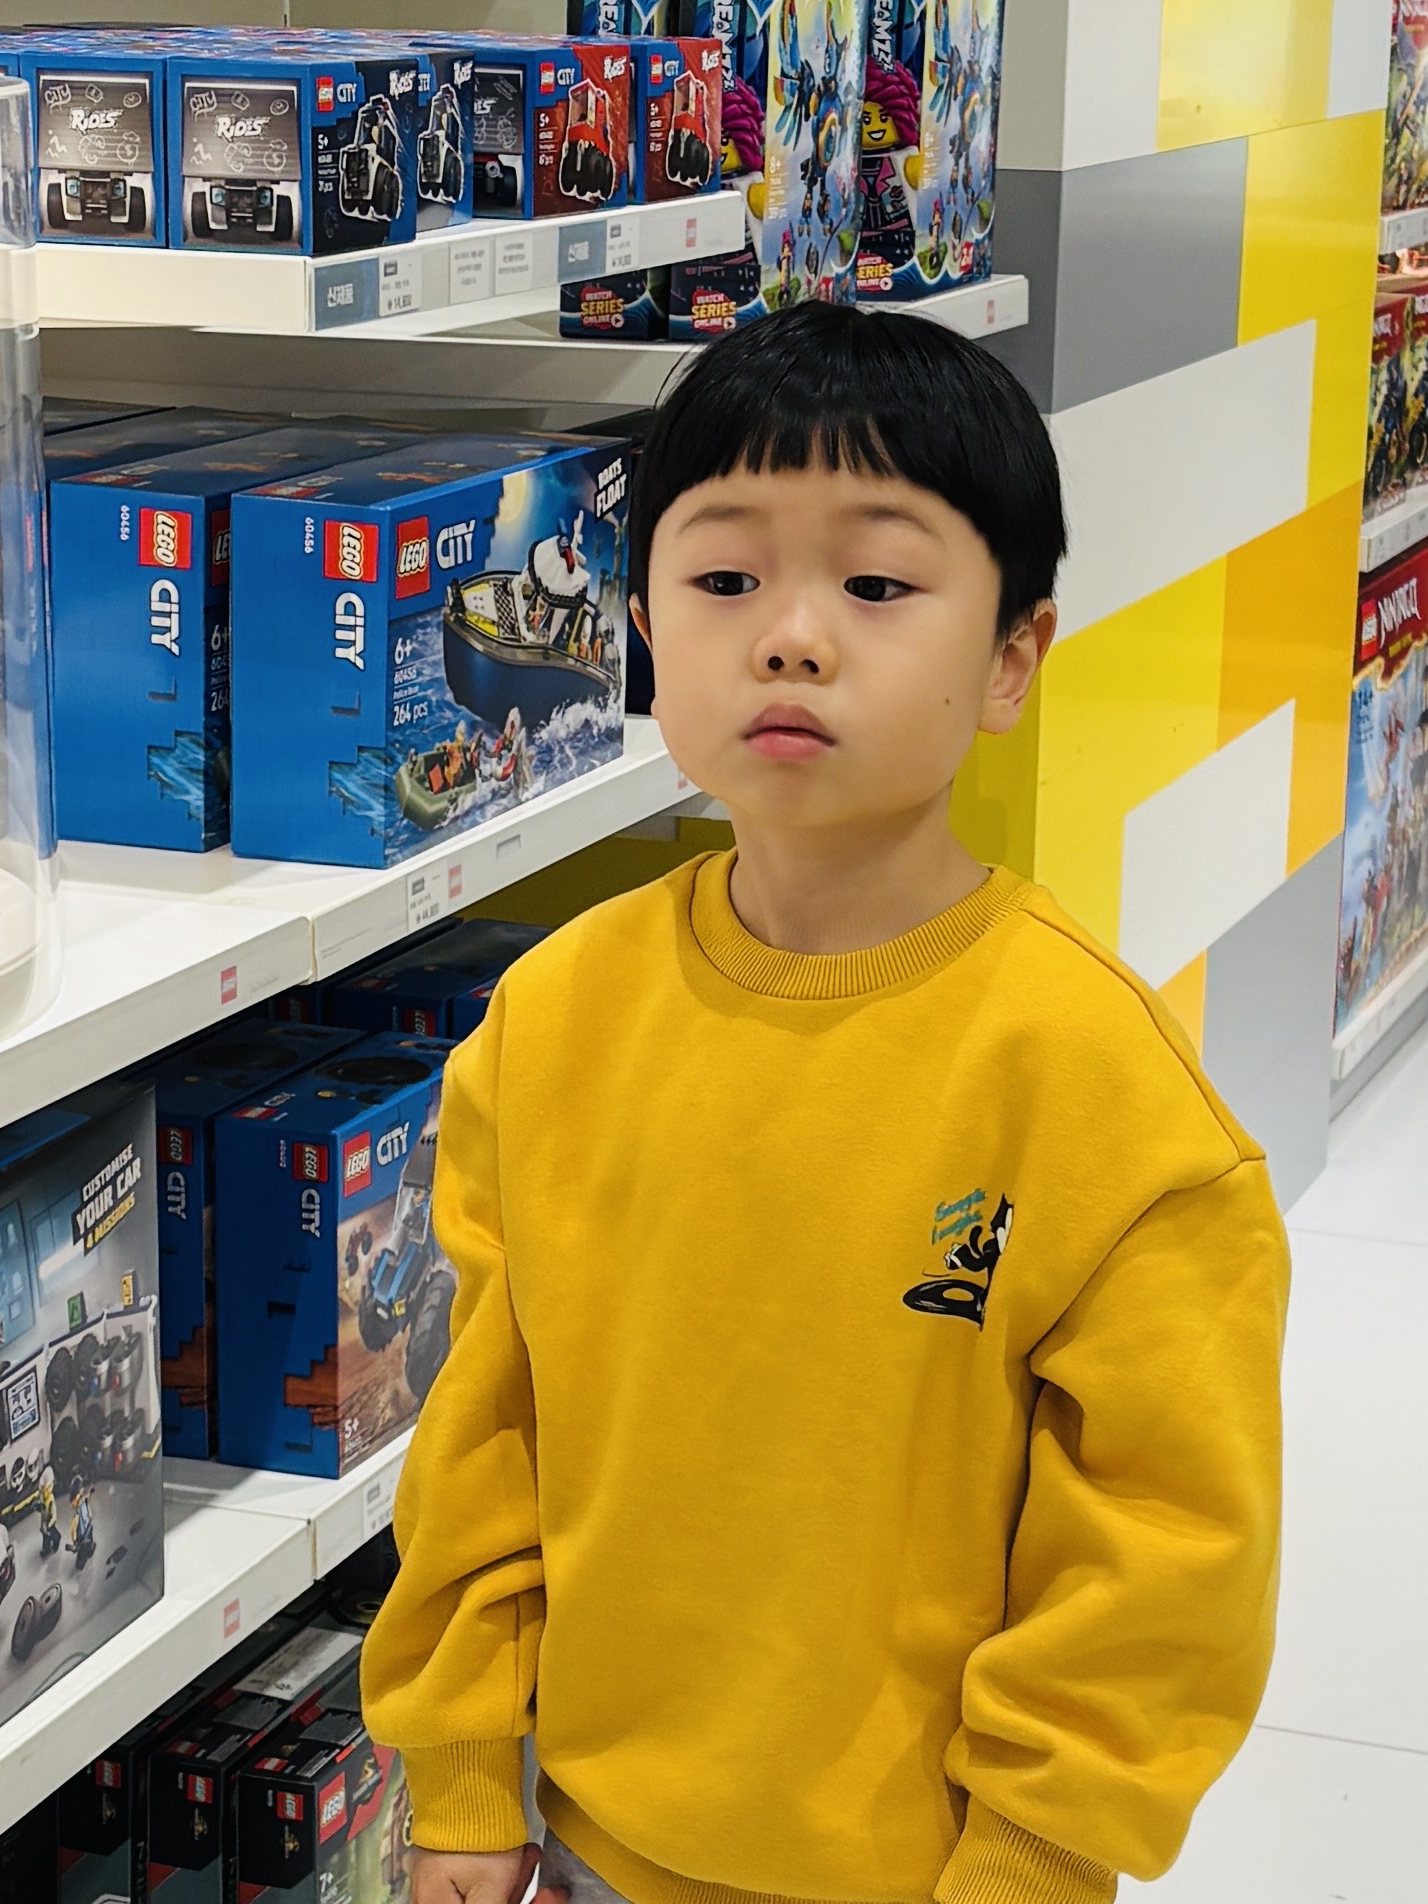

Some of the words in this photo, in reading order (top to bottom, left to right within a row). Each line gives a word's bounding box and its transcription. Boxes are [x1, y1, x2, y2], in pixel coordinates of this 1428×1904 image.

[327, 284, 354, 308] 신제품
[580, 299, 625, 317] SERIES
[691, 301, 737, 318] SERIES
[598, 459, 623, 488] BOATS
[596, 478, 627, 515] FLOAT
[121, 505, 130, 541] 60456
[155, 511, 176, 566] LEGO
[304, 517, 314, 554] 60456
[339, 522, 364, 580] LEGO
[398, 543, 428, 575] LEGO
[393, 637, 413, 666] 6+
[392, 706, 411, 727] 264
[412, 703, 428, 724] pcs
[170, 1128, 183, 1161] LEGO
[82, 1143, 134, 1202] CUSTOMISE
[304, 1146, 318, 1177] LEGO
[344, 1149, 370, 1180] LEGO
[76, 1182, 113, 1235] YOUR
[116, 1157, 142, 1200] CAR
[344, 1418, 360, 1439] 5+
[322, 1788, 346, 1826] LEGO
